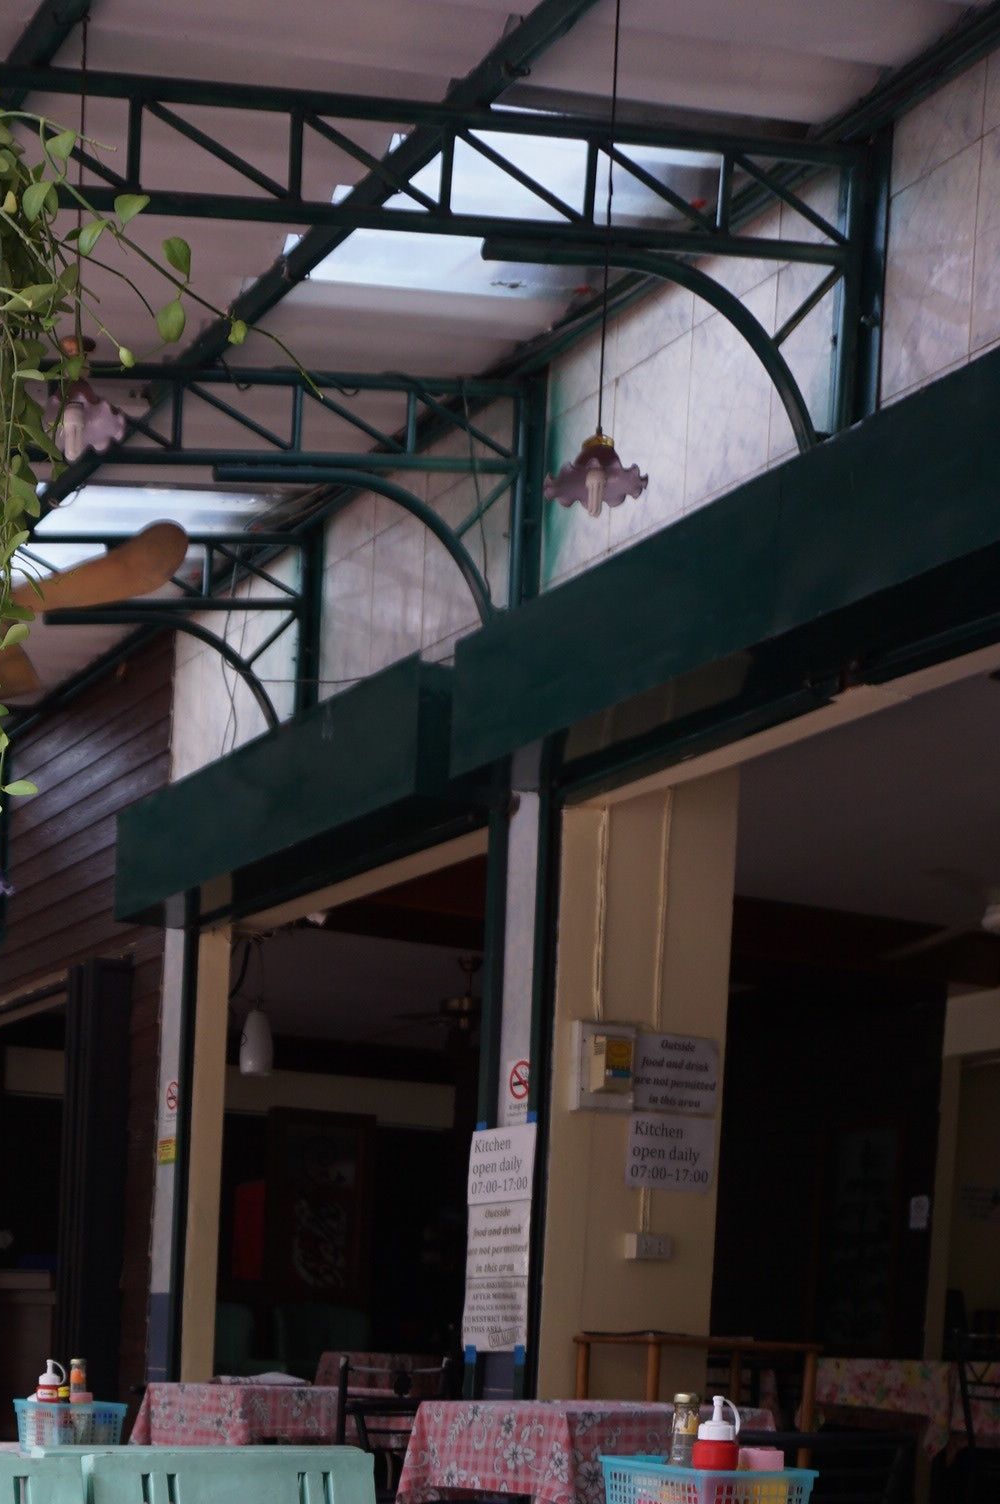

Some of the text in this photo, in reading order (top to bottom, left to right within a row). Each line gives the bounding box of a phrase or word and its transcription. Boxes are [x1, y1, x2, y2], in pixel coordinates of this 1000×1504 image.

[660, 1039, 696, 1052] Outside
[641, 1056, 665, 1069] food
[666, 1058, 684, 1069] and
[685, 1060, 710, 1072] drink
[653, 1076, 669, 1087] not
[670, 1079, 716, 1091] permitted
[660, 1095, 676, 1106] this
[677, 1097, 701, 1108] area
[635, 1121, 684, 1139] Kitchen
[474, 1137, 511, 1153] Kitchen
[632, 1145, 701, 1166] open daily
[472, 1156, 522, 1177] open daily
[631, 1164, 709, 1183] 07:00-17:00
[471, 1176, 528, 1195] 07:00-17:00
[484, 1207, 511, 1219] Outside
[473, 1224, 521, 1239] food and drink
[479, 1246, 490, 1255] not
[491, 1243, 527, 1256] permitted
[484, 1263, 498, 1272] this
